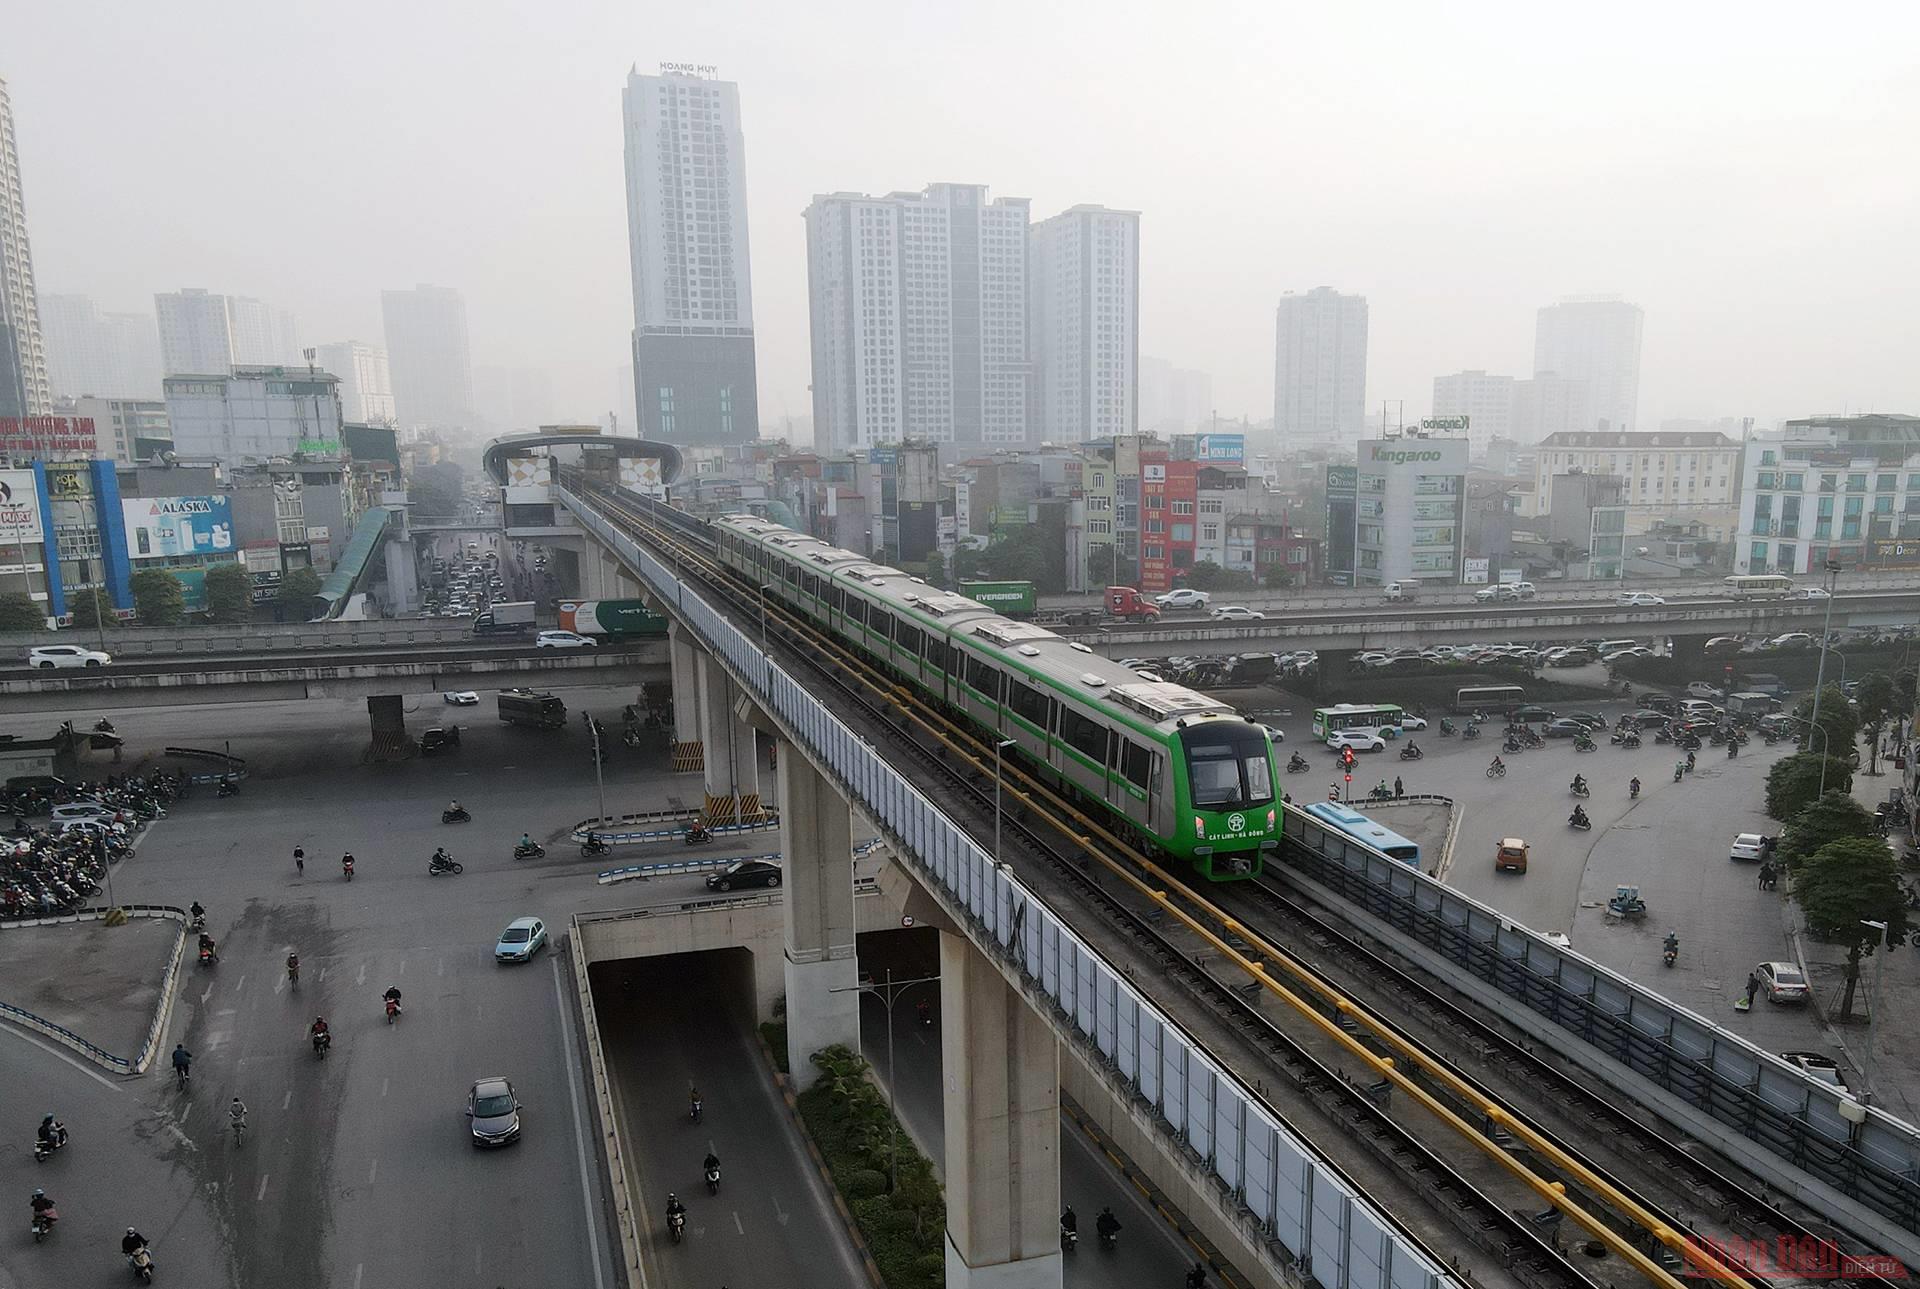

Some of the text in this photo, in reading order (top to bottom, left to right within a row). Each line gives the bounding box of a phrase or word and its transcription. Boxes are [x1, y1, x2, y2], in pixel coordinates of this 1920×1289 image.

[697, 65, 717, 73] HUY
[1371, 447, 1441, 464] Kangaroo
[162, 501, 210, 513] ALASKA
[2, 511, 31, 523] MART
[976, 592, 1023, 601] EVERGREEN
[1209, 833, 1221, 841] CÁT
[1222, 832, 1235, 840] LINH
